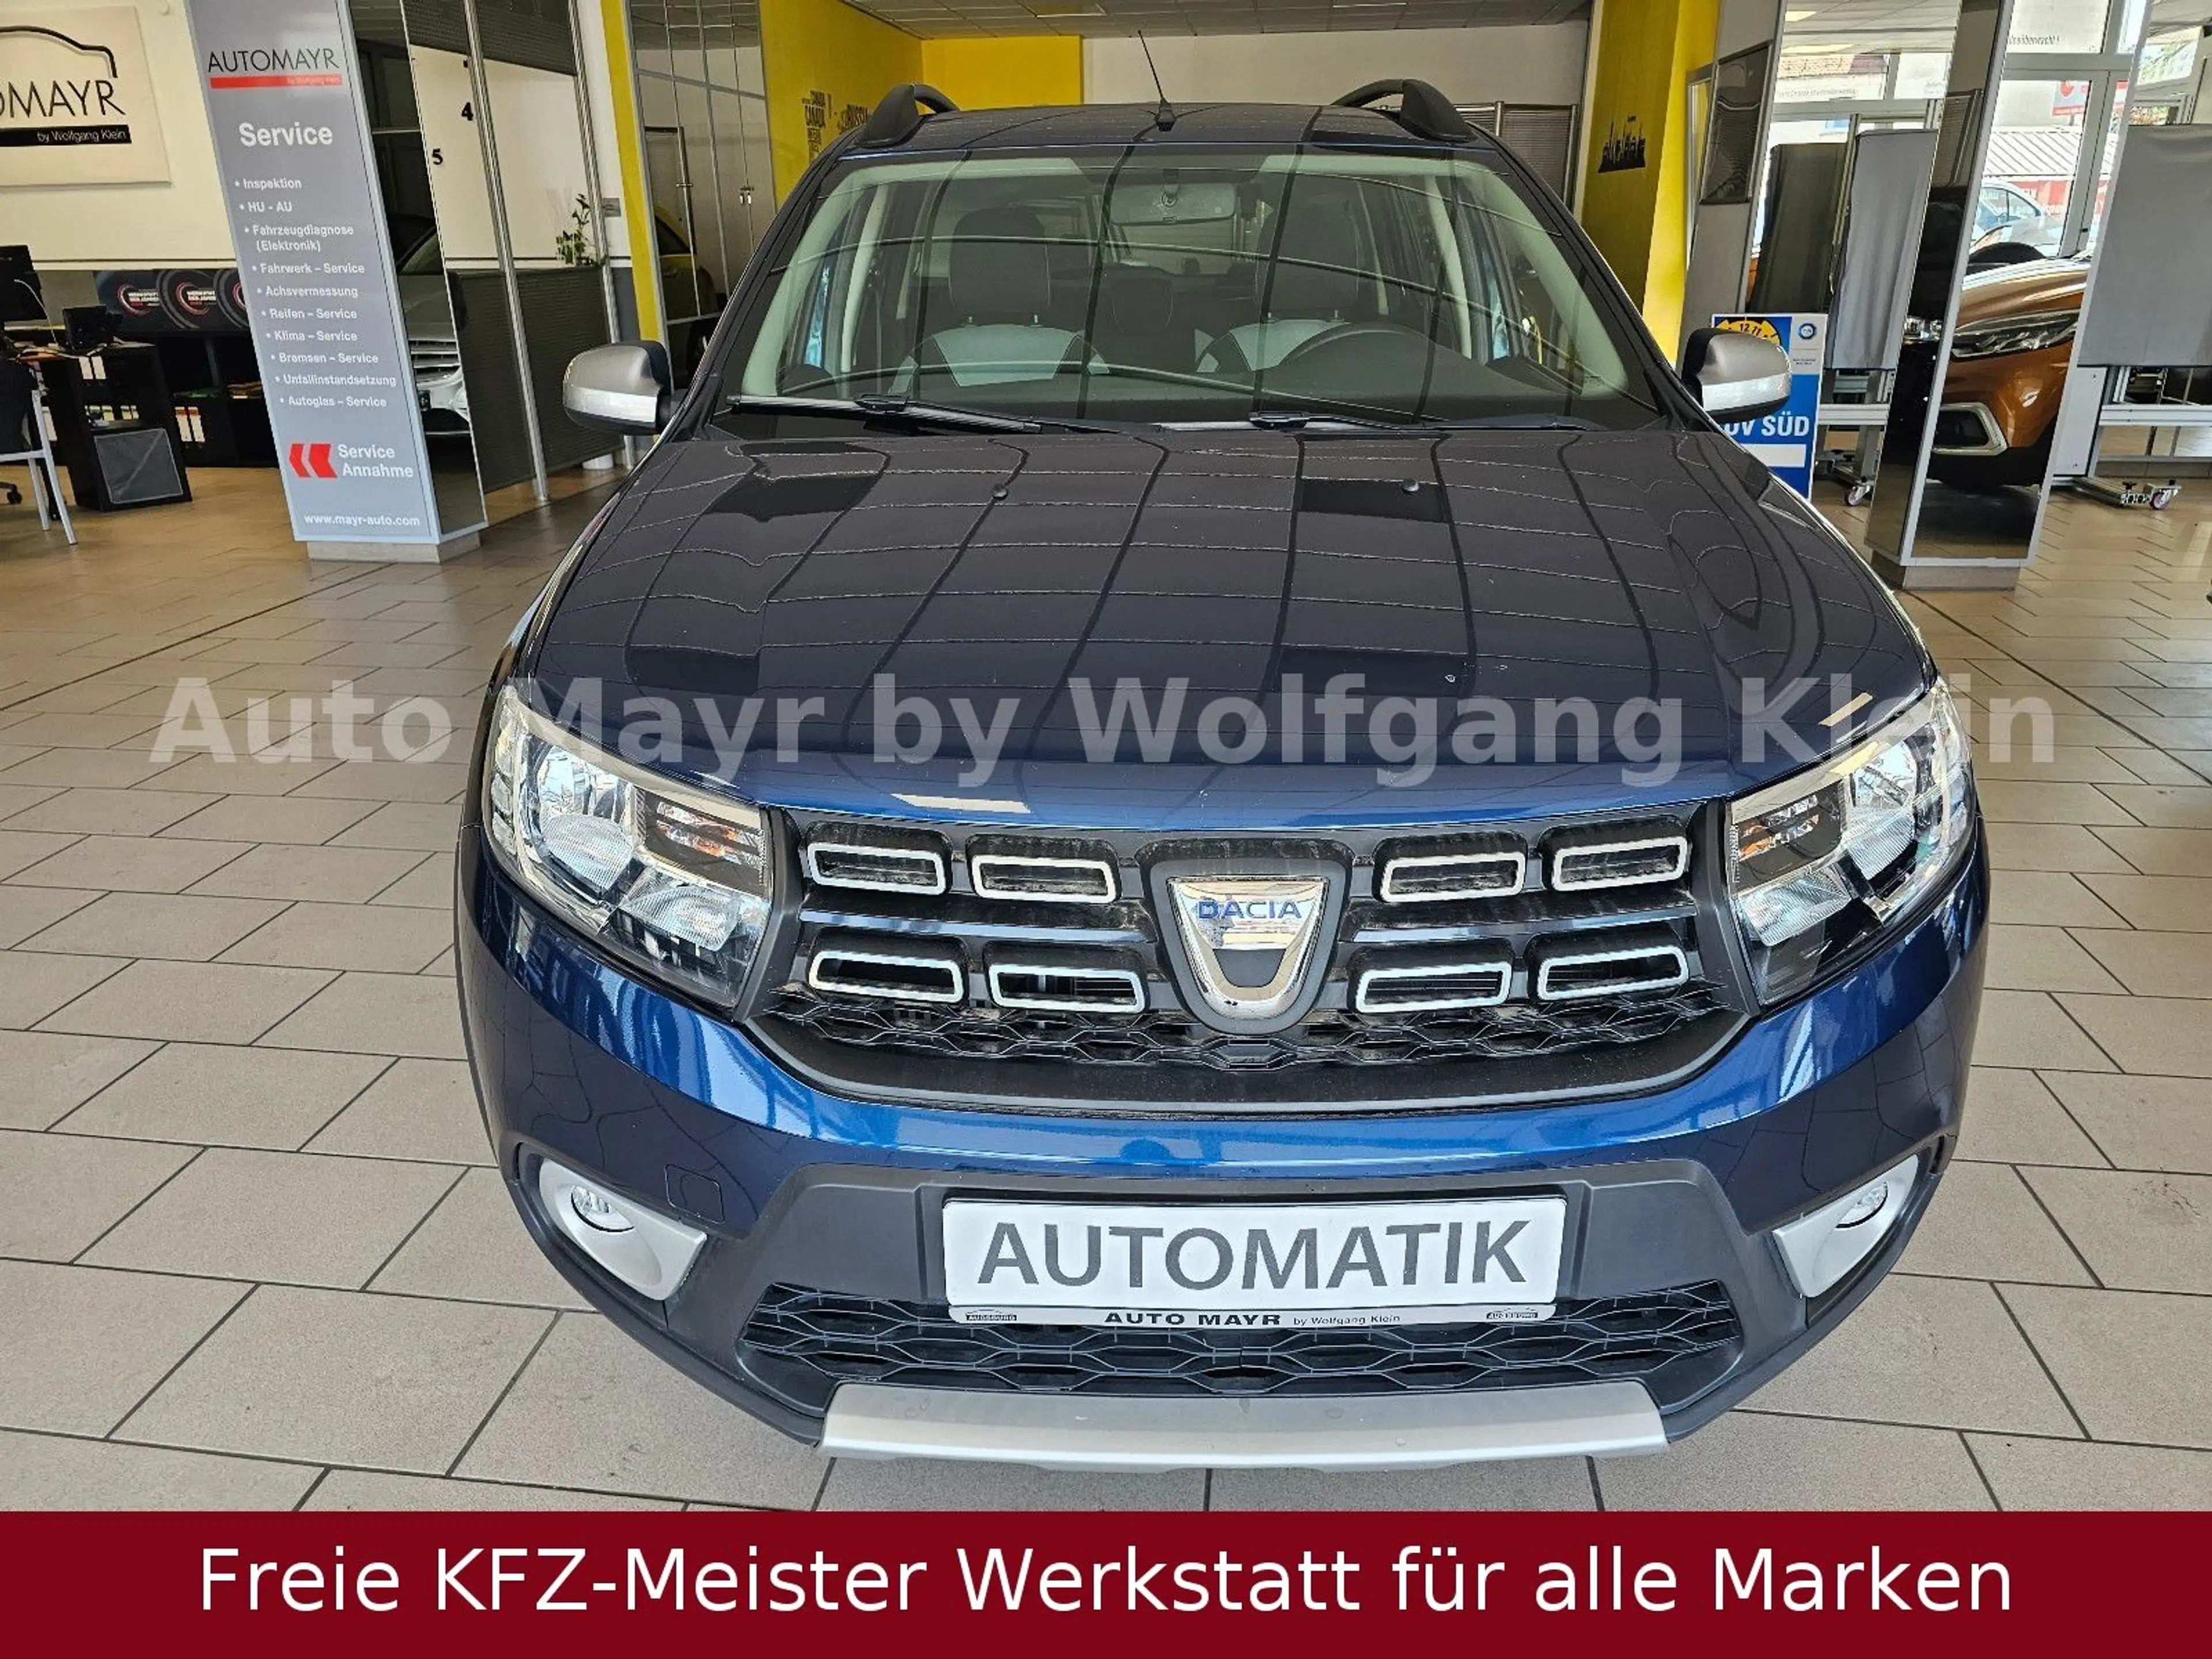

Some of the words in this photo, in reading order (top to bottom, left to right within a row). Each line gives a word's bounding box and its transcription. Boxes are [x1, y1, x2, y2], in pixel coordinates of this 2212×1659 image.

[208, 48, 339, 73] AUTOMAYR
[0, 80, 126, 118] MAYR
[461, 102, 474, 121] 4
[37, 131, 50, 142] by
[51, 129, 100, 141] Wolfgang
[101, 128, 126, 139] Klein
[239, 122, 333, 147] Service
[432, 148, 443, 165] 5
[243, 179, 302, 191] Inspektion
[248, 202, 265, 212] HU
[276, 202, 293, 212] AU
[252, 224, 354, 237] Fahrzeugdiagnose
[256, 240, 321, 252] (Elektronik)
[259, 263, 312, 274] Fahrwerk
[324, 263, 365, 274] Service
[265, 286, 358, 298] Achsvermessung
[269, 308, 305, 319] Reifen
[316, 308, 357, 319] Service
[274, 330, 305, 341] Klima
[317, 330, 358, 341] Service
[279, 353, 327, 363] Bremsen
[338, 353, 378, 363] Service
[283, 374, 396, 387] Unfallinstandsetzung
[288, 396, 335, 407] Autoglas
[346, 396, 387, 407] Service
[1761, 411, 1810, 437] SÜD
[338, 444, 395, 459] Service
[342, 463, 414, 478] Annahme
[304, 514, 420, 527] www.mayr-auto.com
[1198, 900, 1302, 919] DACIA
[977, 1219, 1532, 1290] AUTOMATIK
[1104, 1312, 1185, 1325] AUTO
[1198, 1313, 1282, 1325] MAYR
[1293, 1317, 1307, 1326] by
[1311, 1317, 1366, 1325] Wolfgang
[1370, 1315, 1400, 1323] Klein
